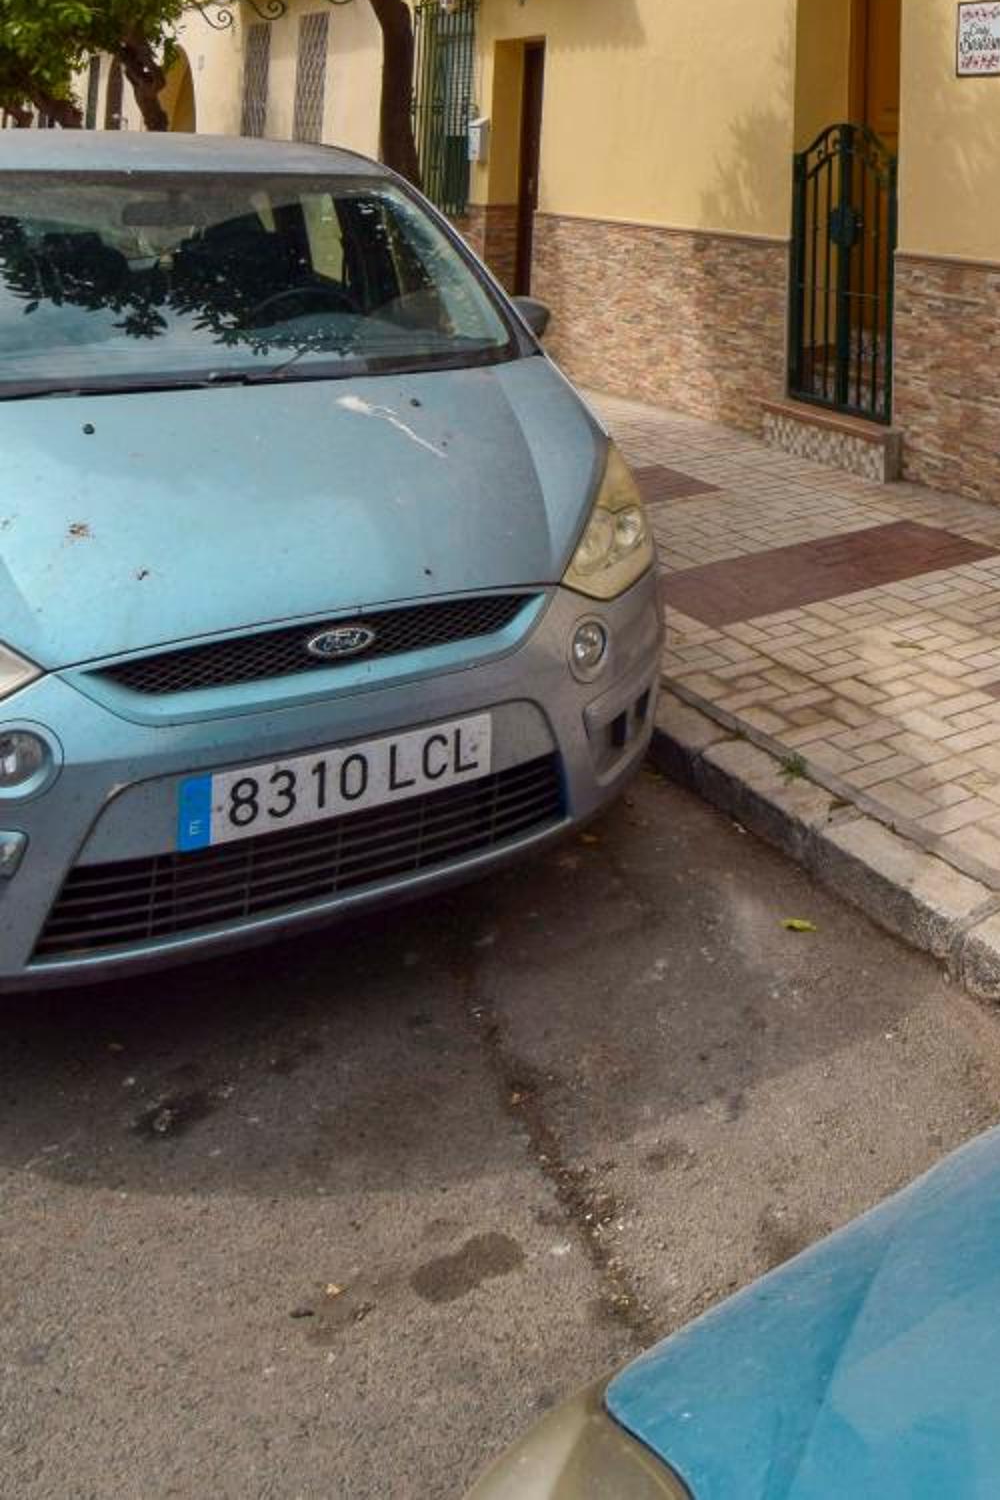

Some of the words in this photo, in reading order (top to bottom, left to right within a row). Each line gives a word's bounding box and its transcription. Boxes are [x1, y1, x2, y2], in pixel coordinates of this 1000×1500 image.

[321, 631, 362, 652] Ford
[229, 753, 368, 827] 8310
[389, 728, 479, 791] LCL
[189, 819, 202, 837] E
